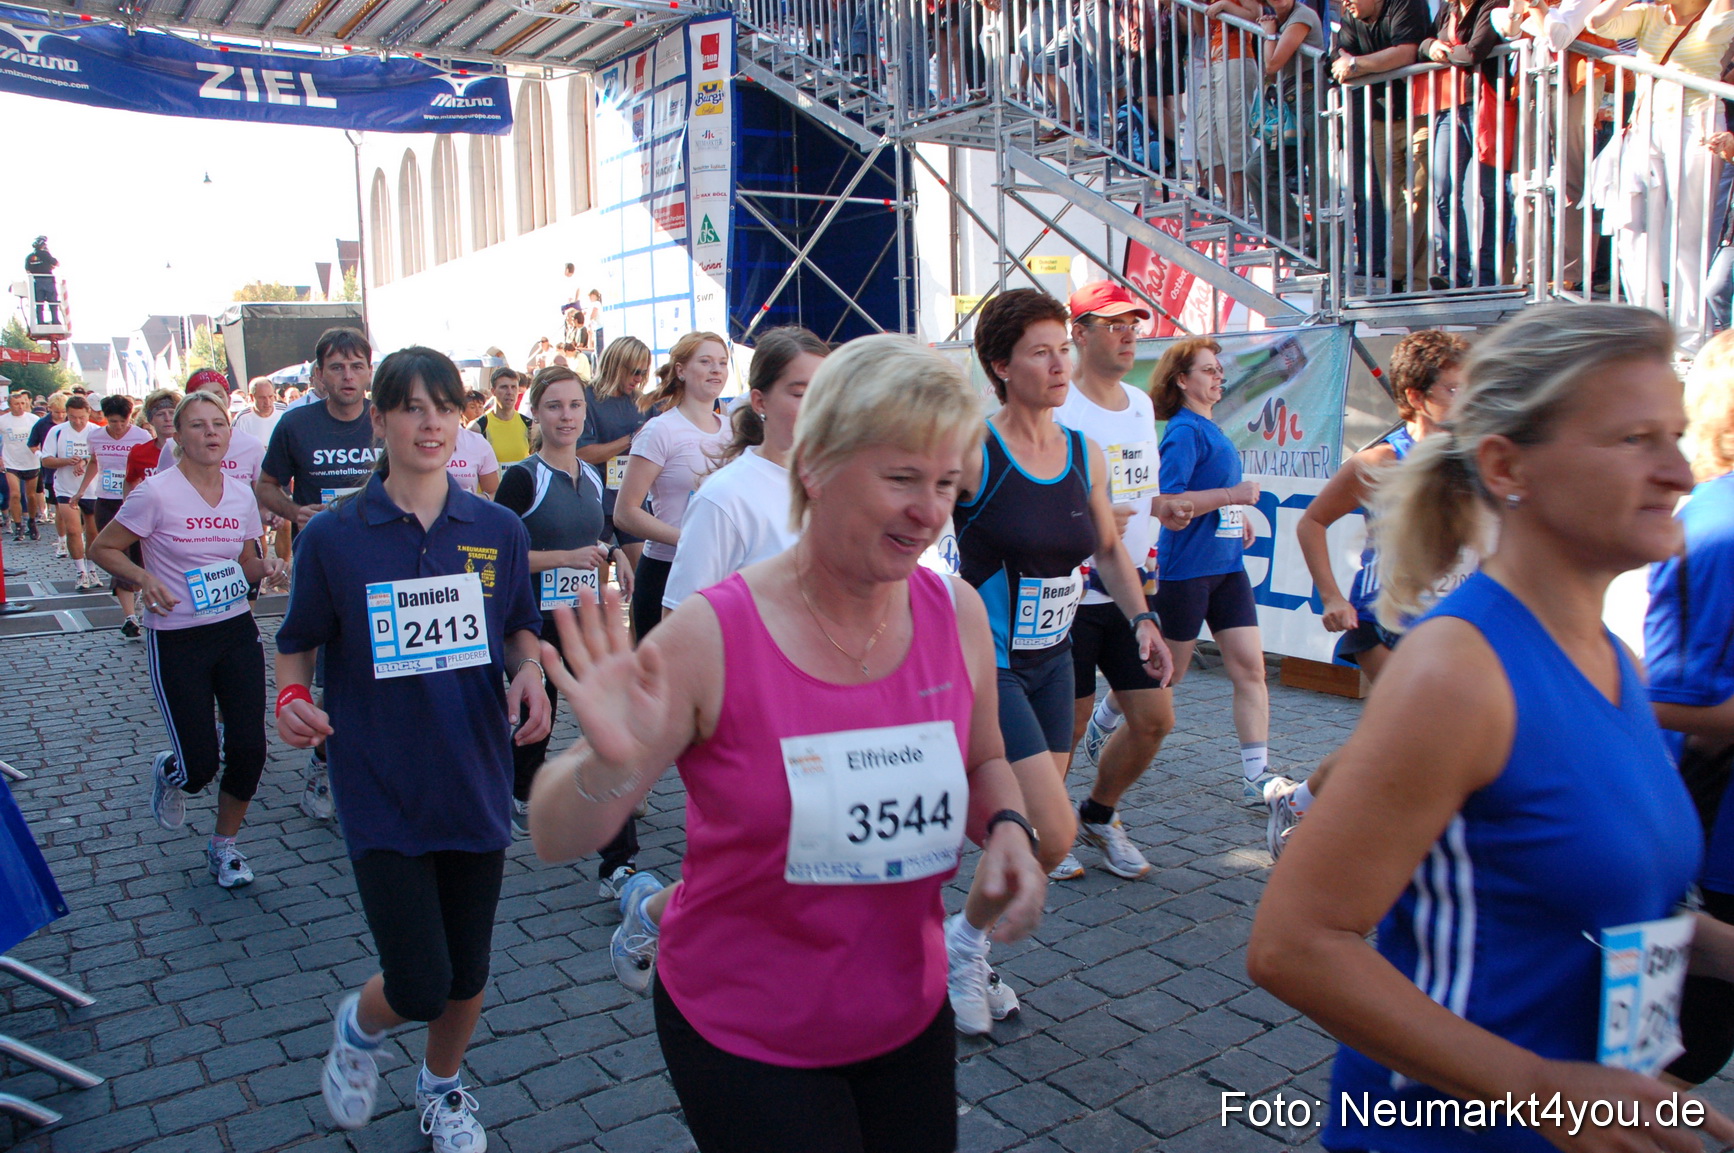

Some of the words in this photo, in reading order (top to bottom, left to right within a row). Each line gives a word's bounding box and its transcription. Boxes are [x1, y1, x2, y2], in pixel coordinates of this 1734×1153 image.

[196, 62, 337, 109] ZIEL
[1124, 465, 1150, 485] 194
[186, 517, 240, 530] SYSCAD
[204, 566, 236, 583] Kerstin
[545, 573, 553, 583] D
[195, 589, 204, 599] D
[211, 579, 247, 604] 2103
[397, 586, 460, 609] Daniela
[1022, 605, 1032, 617] C
[377, 619, 391, 634] D
[403, 613, 480, 649] 2413
[447, 650, 488, 663] PFLEIDERER
[846, 744, 924, 772] Elfriede
[846, 790, 953, 845] 3544
